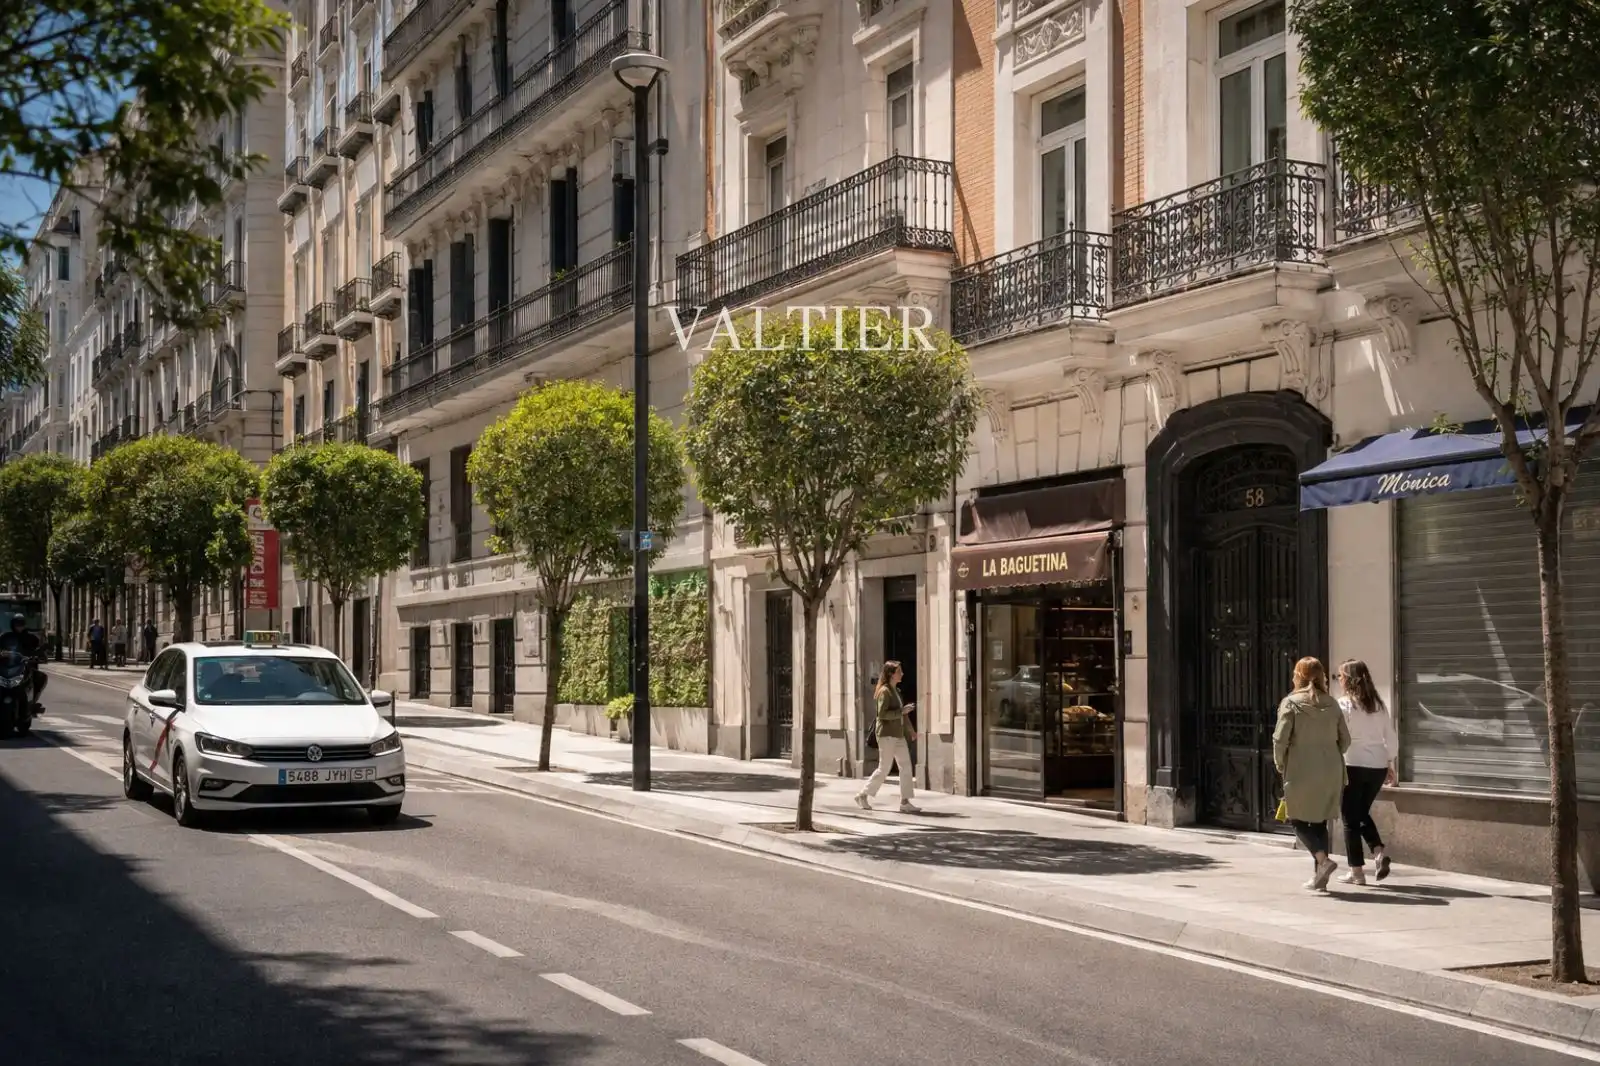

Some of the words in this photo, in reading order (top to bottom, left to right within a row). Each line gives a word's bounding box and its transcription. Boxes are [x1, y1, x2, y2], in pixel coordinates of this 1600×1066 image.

[1377, 473, 1450, 495] Mónica
[1245, 488, 1265, 508] 58
[982, 559, 997, 577] LA
[1000, 552, 1068, 576] BAGUETINA
[288, 770, 319, 782] 5488
[325, 770, 347, 782] JYH
